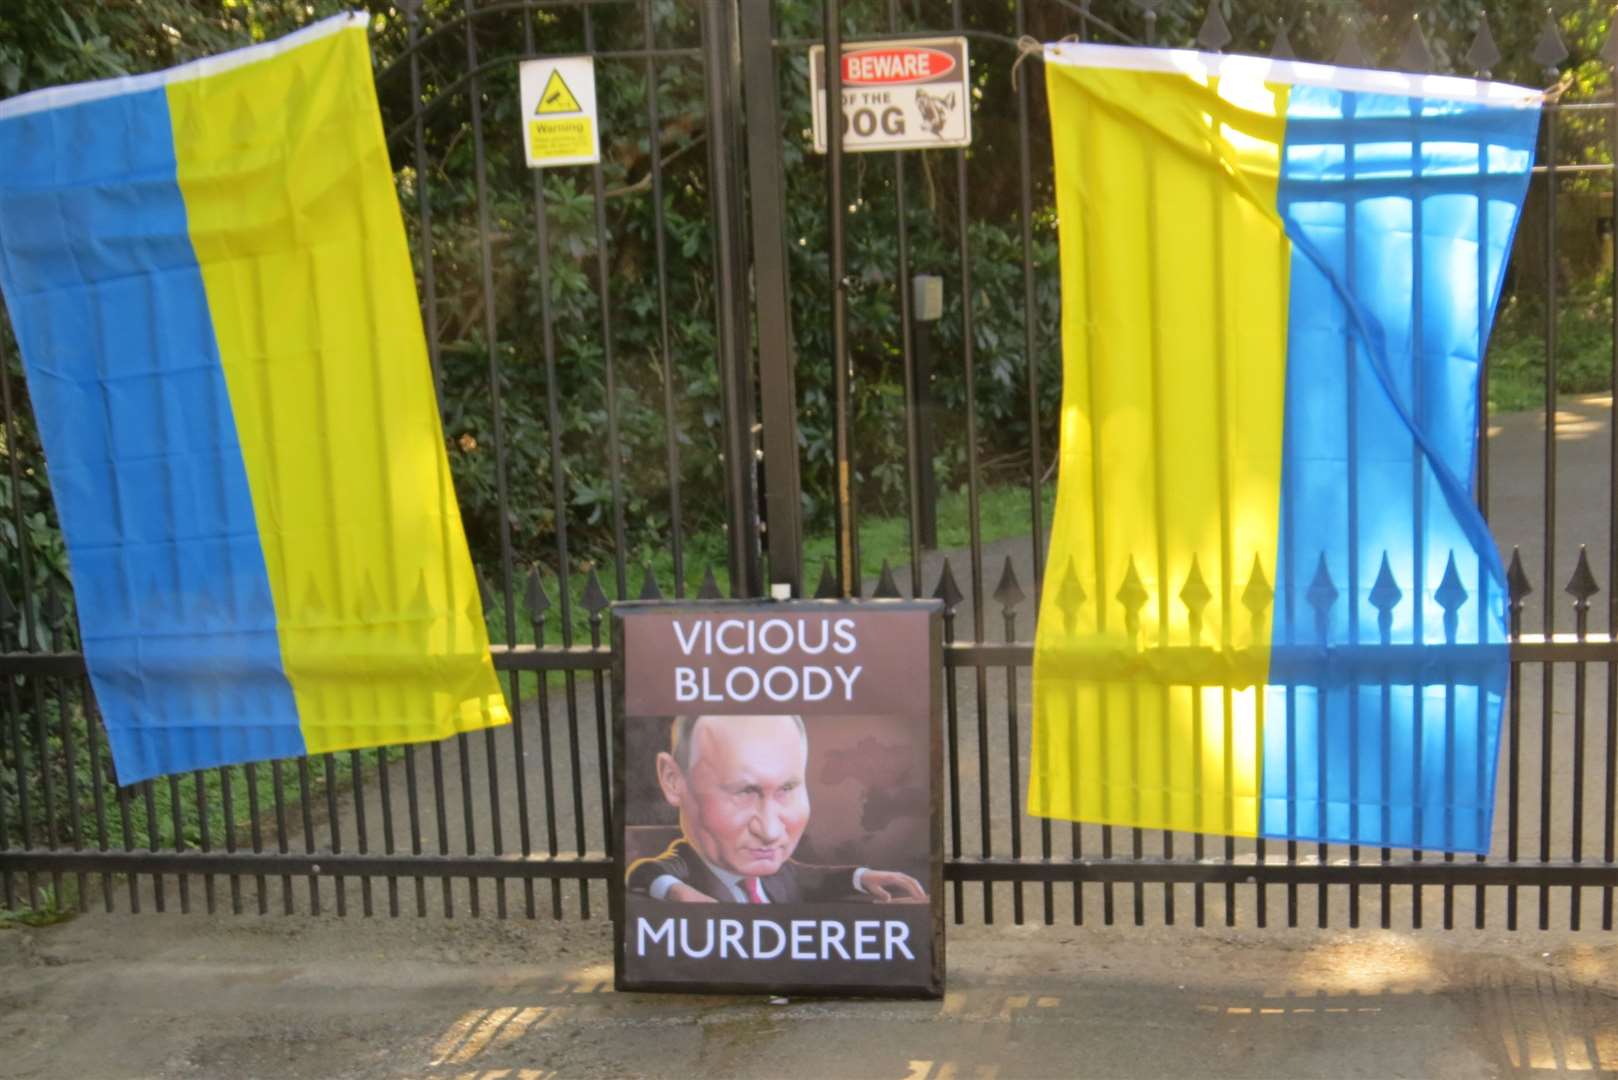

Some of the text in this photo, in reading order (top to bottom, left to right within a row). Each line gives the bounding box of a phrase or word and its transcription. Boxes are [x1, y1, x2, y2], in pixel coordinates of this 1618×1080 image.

[847, 53, 930, 80] BEWARE
[863, 91, 891, 105] THE
[536, 122, 584, 134] Warning
[673, 619, 857, 655] VICIOUS
[675, 666, 862, 702] BLOODY
[637, 918, 915, 961] MURDERER
